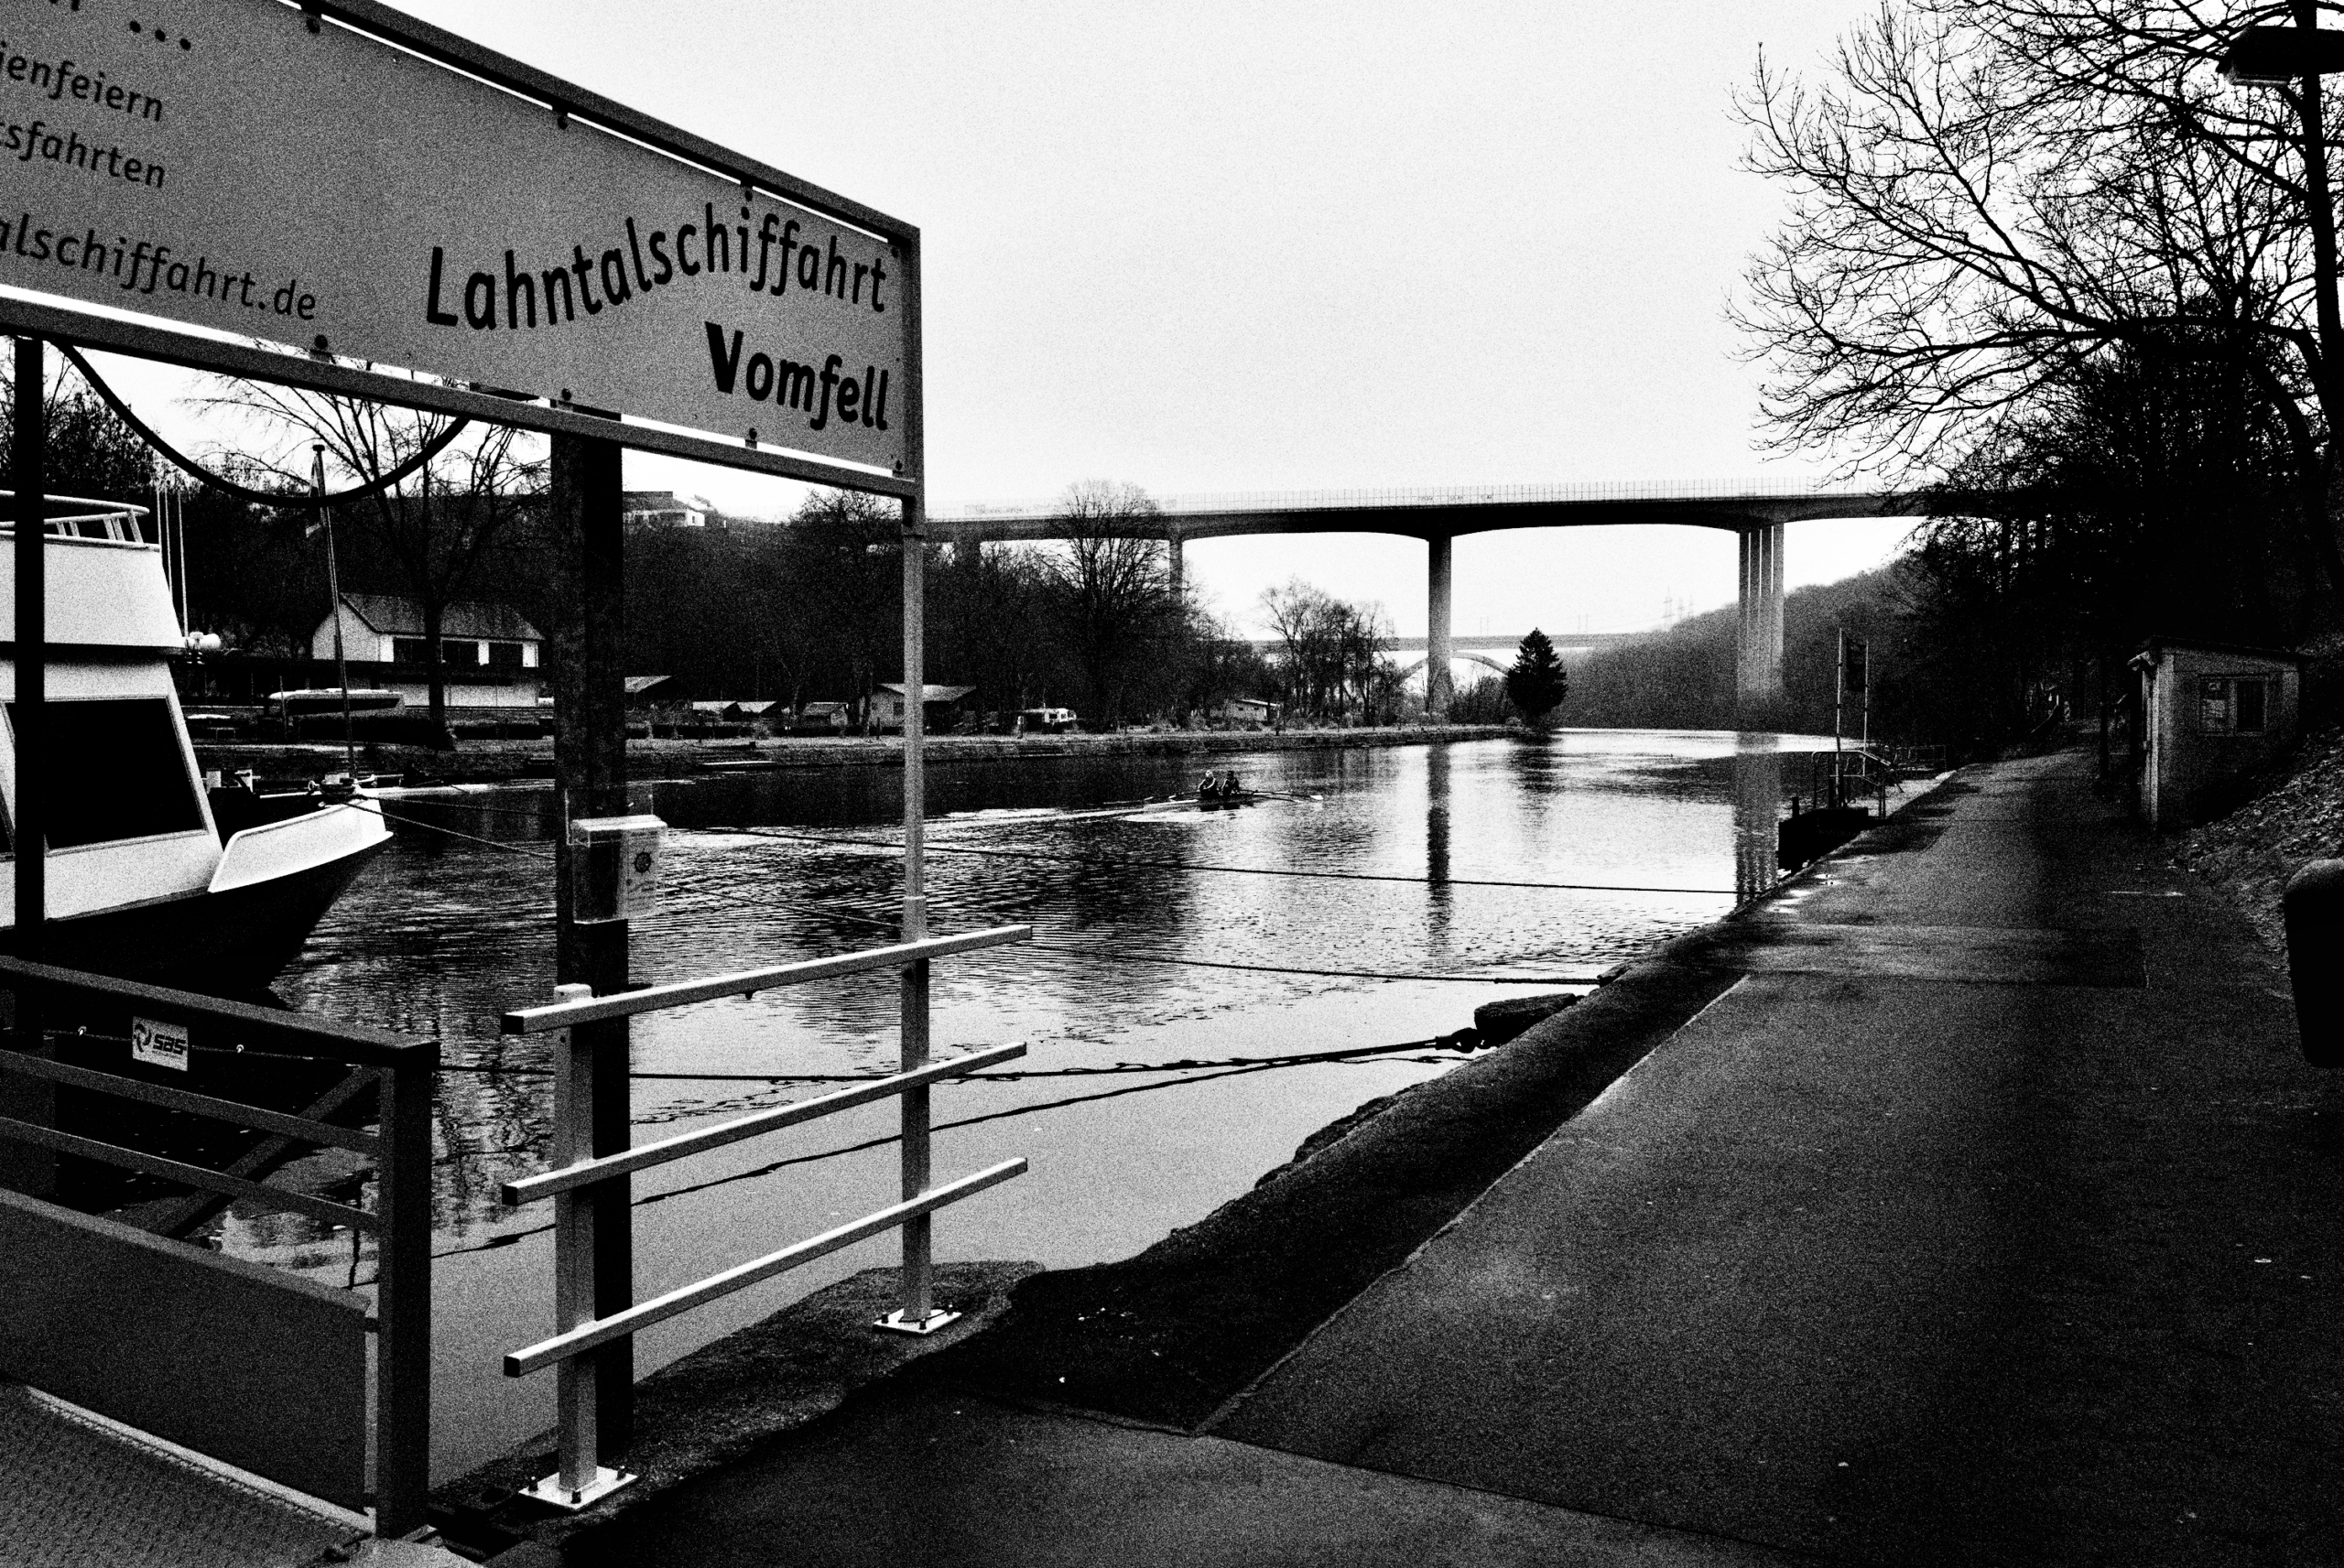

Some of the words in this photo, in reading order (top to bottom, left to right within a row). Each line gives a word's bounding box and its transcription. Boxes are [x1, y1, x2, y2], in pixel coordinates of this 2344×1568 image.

[0, 120, 165, 189] sfahrten
[426, 201, 886, 330] Lahntalschiffahrt
[704, 320, 889, 431] Vomfell
